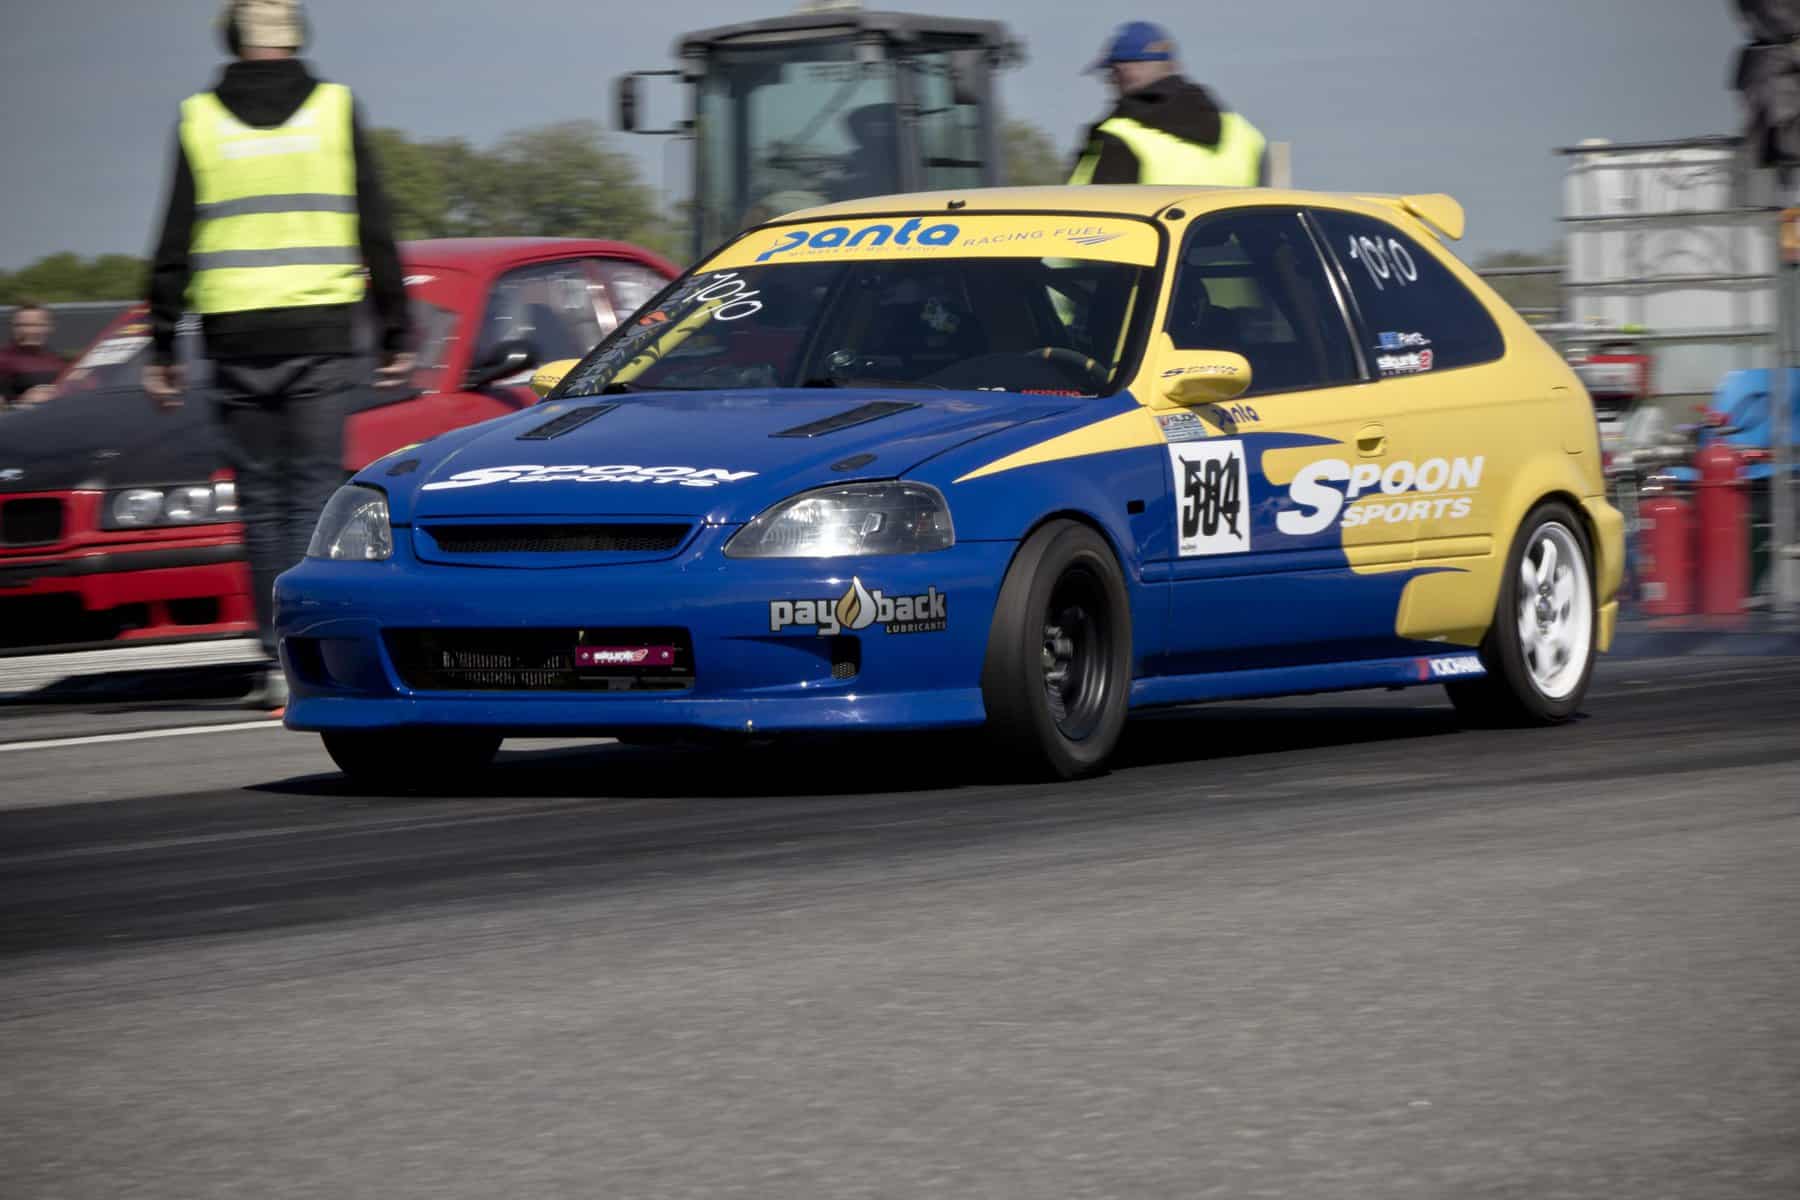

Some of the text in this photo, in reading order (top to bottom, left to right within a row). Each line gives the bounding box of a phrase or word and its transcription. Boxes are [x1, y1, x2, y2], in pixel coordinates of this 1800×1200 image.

[755, 217, 959, 262] panta
[963, 226, 1106, 247] RACING FUEL
[422, 465, 759, 490] SPOON
[509, 475, 720, 487] SPORTS
[1276, 456, 1484, 535] SPOON
[1340, 498, 1472, 527] SPORTS
[886, 621, 947, 633] LUBRICANTS
